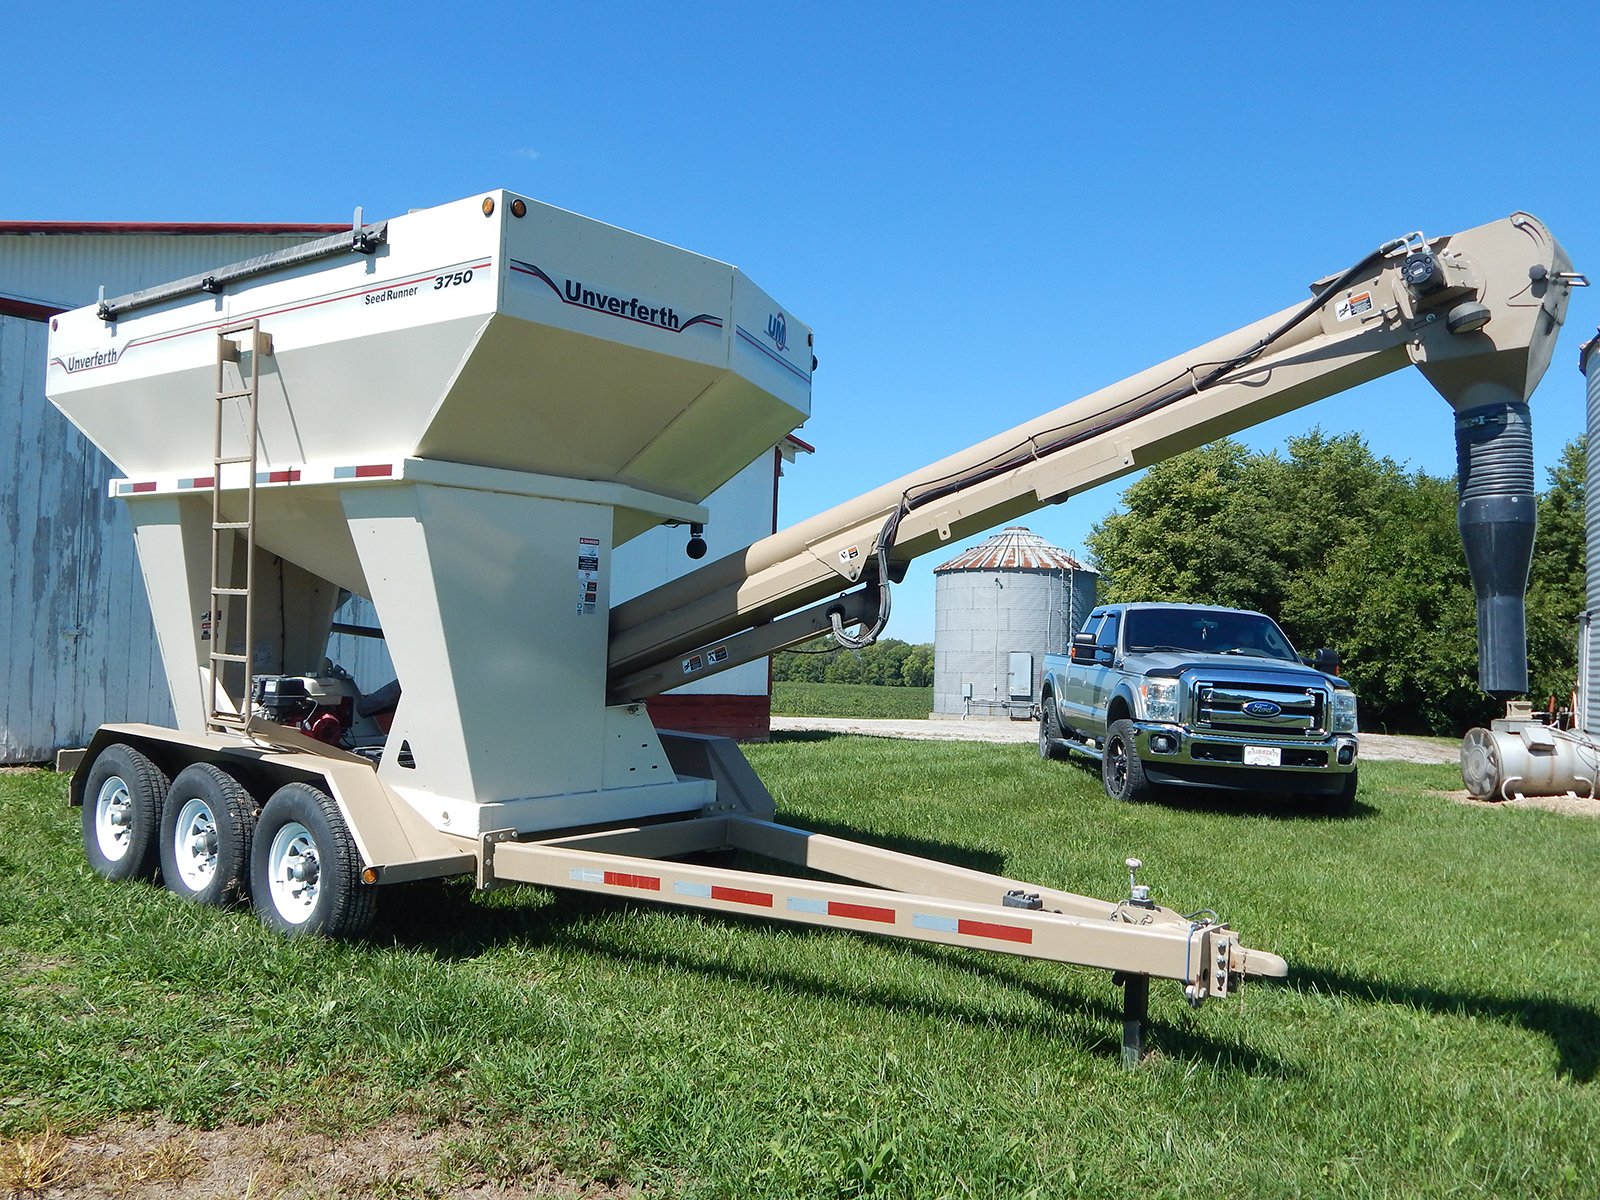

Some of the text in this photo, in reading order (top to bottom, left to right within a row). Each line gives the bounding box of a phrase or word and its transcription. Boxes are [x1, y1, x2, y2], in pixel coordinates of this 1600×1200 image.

[434, 270, 473, 290] 3750
[565, 279, 679, 329] Unverferth
[68, 348, 117, 371] Unverferth
[1252, 703, 1273, 713] Ford
